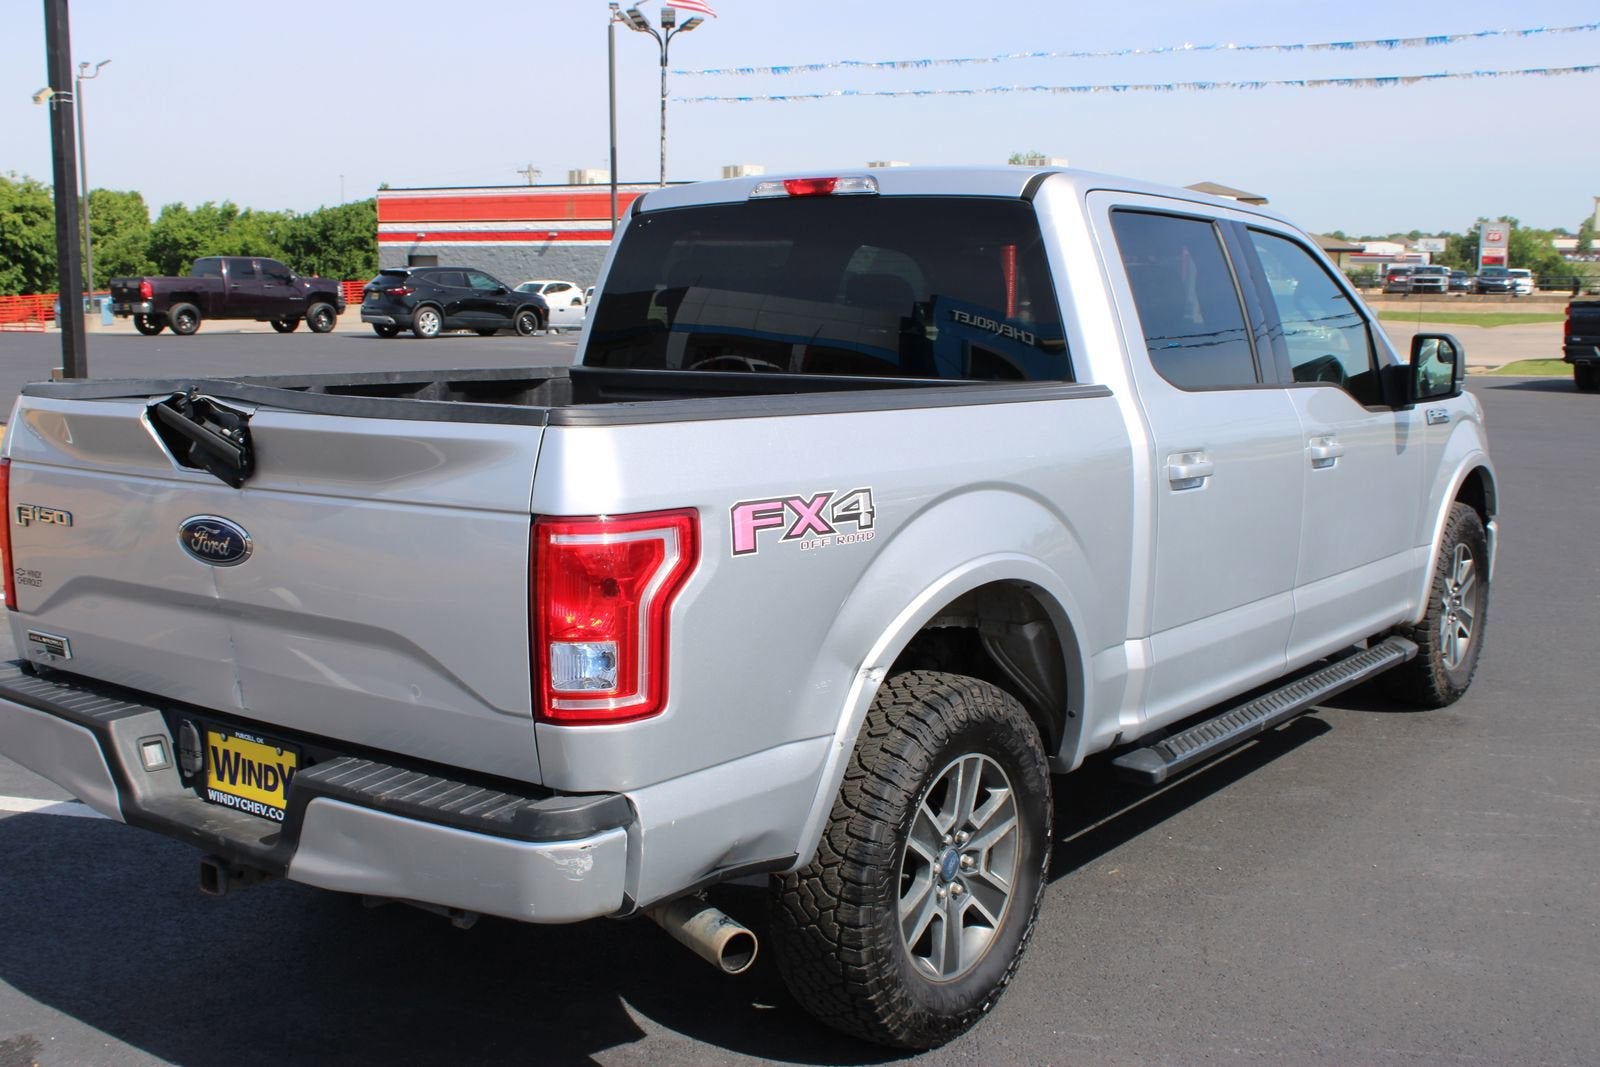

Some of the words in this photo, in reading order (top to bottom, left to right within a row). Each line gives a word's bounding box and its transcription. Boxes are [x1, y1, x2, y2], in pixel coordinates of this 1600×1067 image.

[730, 486, 876, 558] FX4
[191, 525, 231, 556] Ford
[800, 538, 831, 551] OFF
[836, 531, 876, 545] ROAD
[210, 746, 296, 800] WINDY
[207, 788, 285, 821] WINDYCHEV.CO
